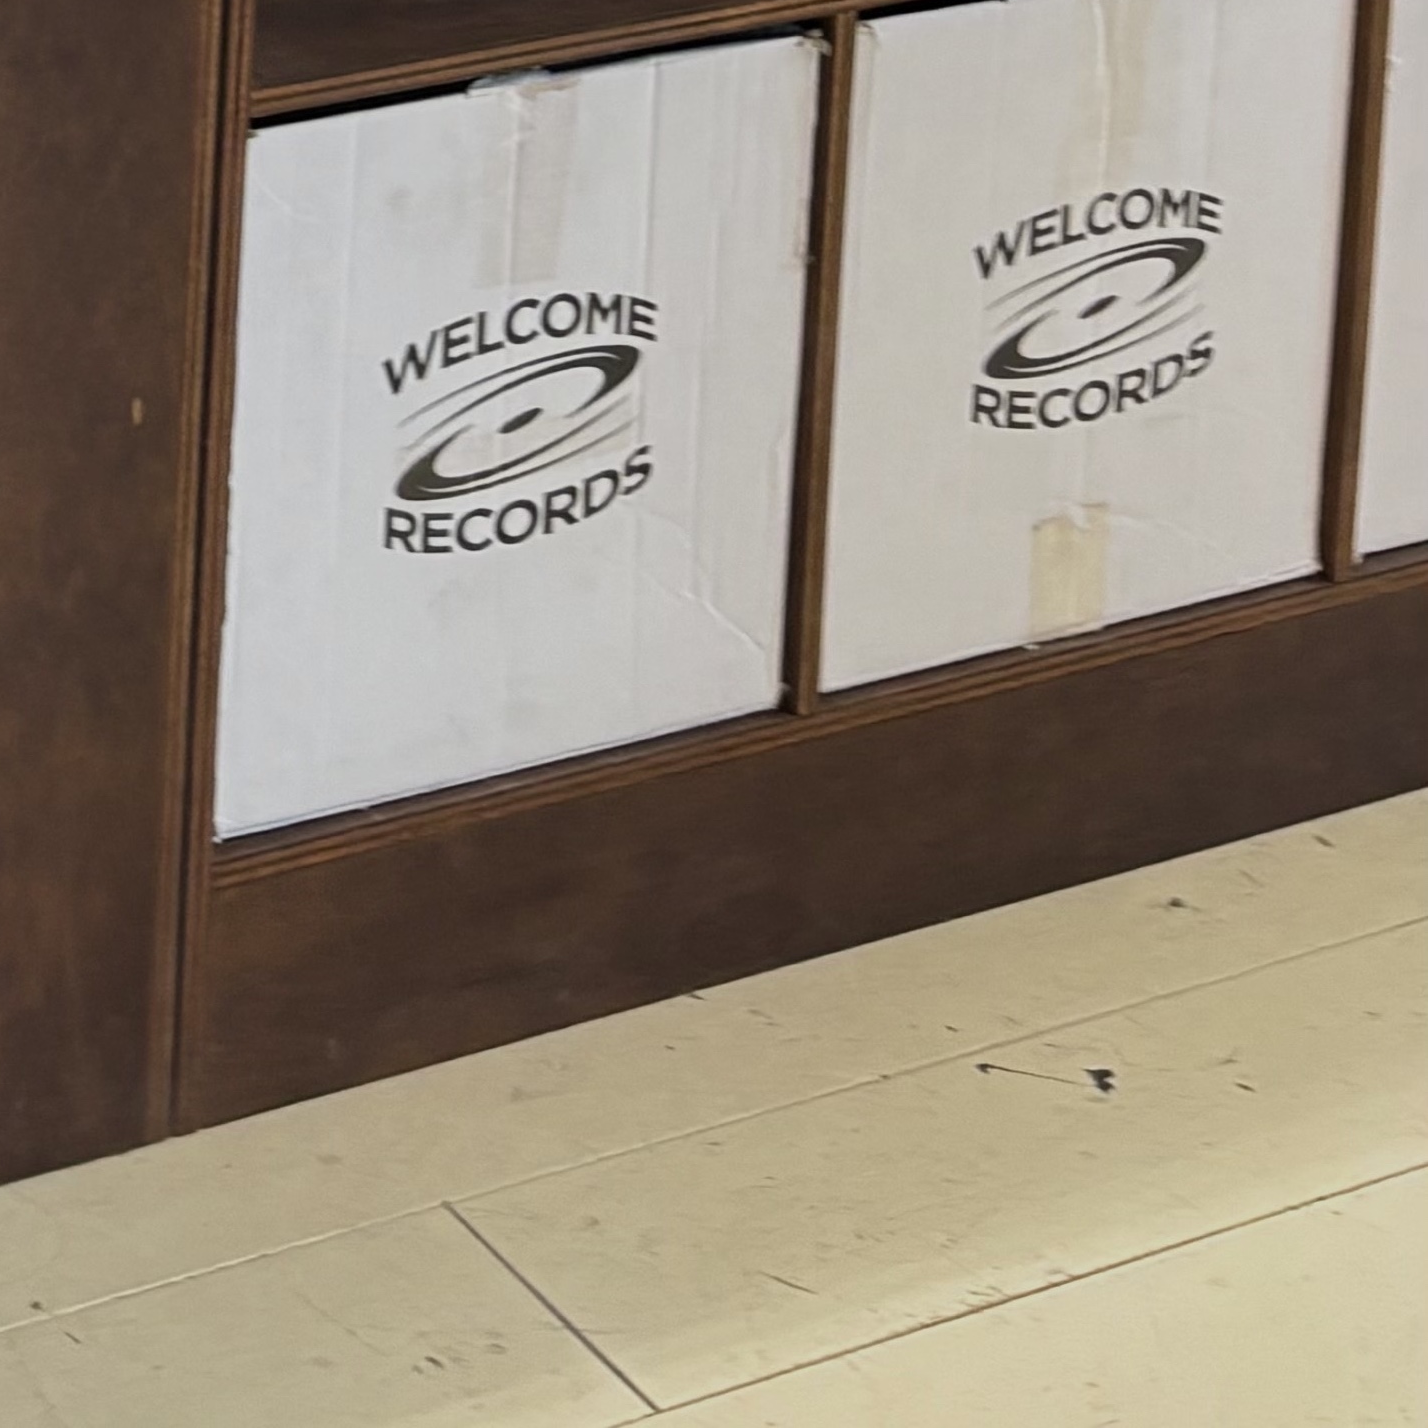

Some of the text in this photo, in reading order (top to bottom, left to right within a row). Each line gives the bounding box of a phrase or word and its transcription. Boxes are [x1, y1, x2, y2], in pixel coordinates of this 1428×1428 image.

[972, 186, 1225, 281] WELCOME
[381, 291, 659, 396] WELCOME
[969, 329, 1216, 431] RECORDS
[383, 444, 654, 555] RECORDS
